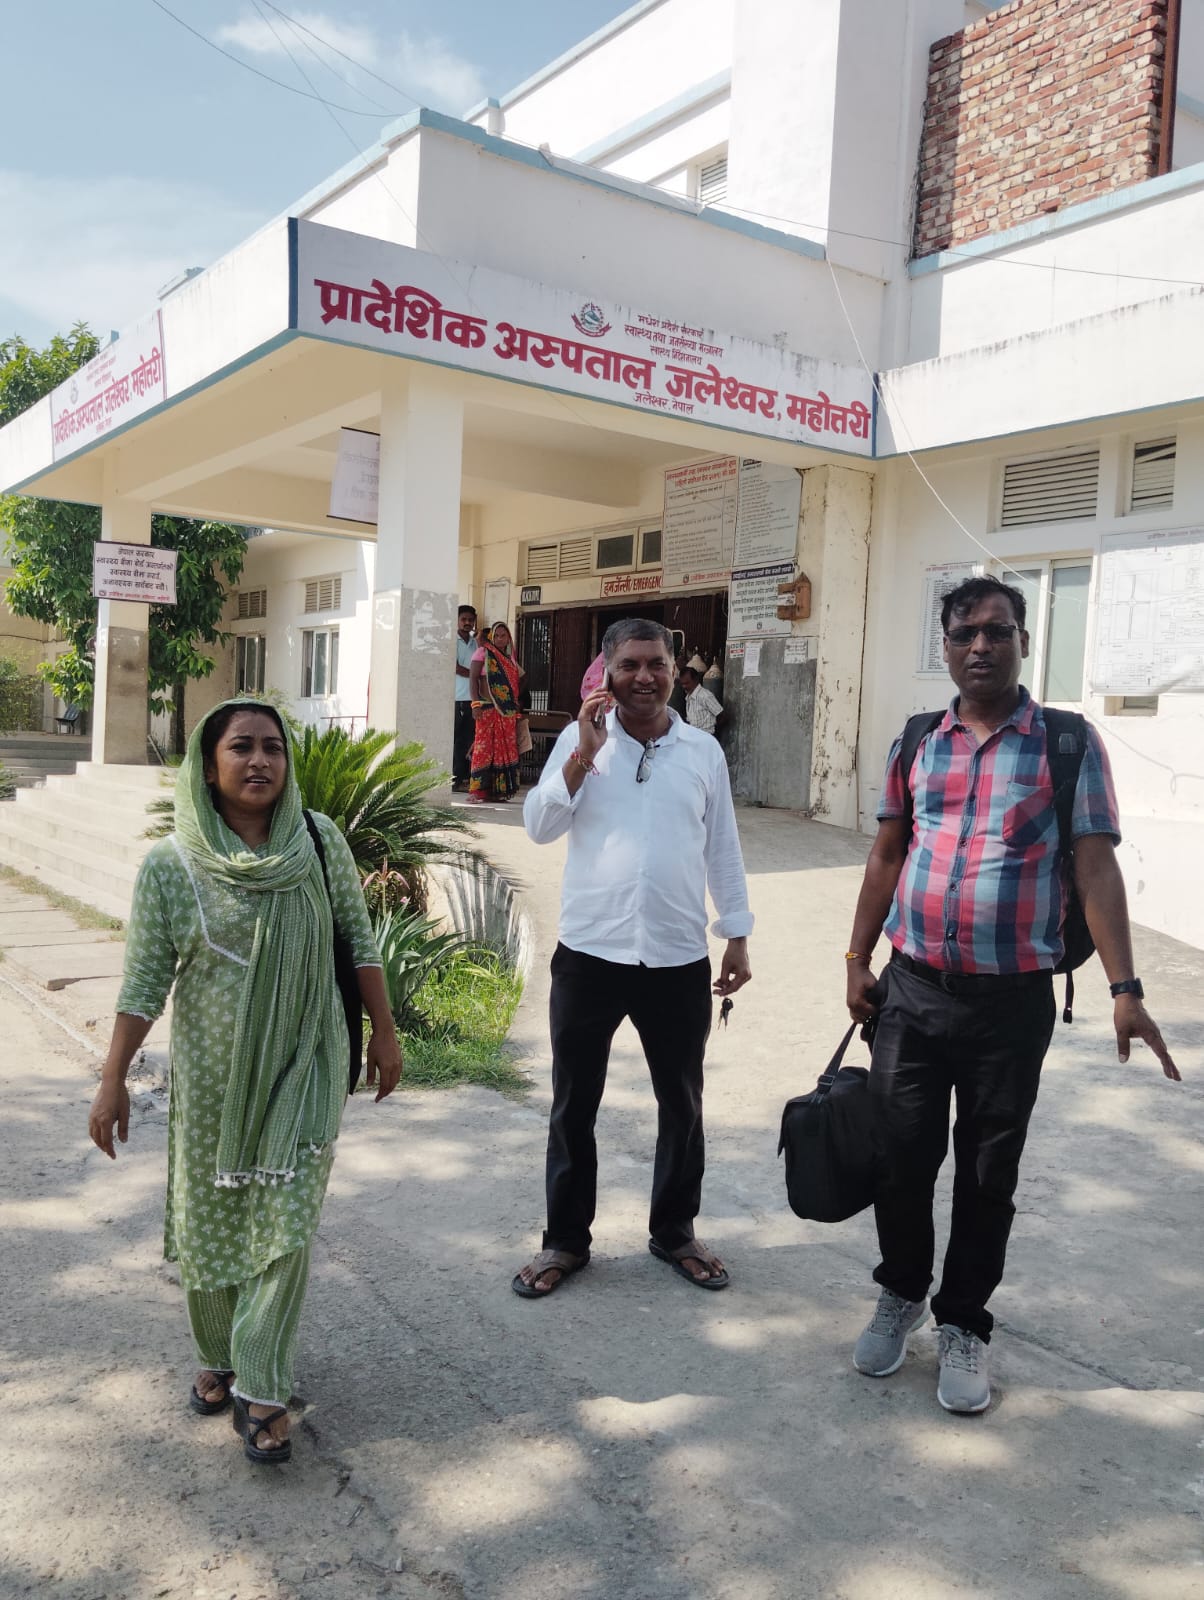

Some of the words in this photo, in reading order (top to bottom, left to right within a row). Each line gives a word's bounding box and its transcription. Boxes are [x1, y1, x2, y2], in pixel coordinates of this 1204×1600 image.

[653, 331, 666, 344] तथा
[313, 278, 488, 349] प्रादेशिक
[492, 321, 656, 390] अस्पताल
[665, 364, 781, 422] जलेश्वर,
[785, 390, 872, 439] महोत्तरी
[672, 398, 695, 414] नेपाल
